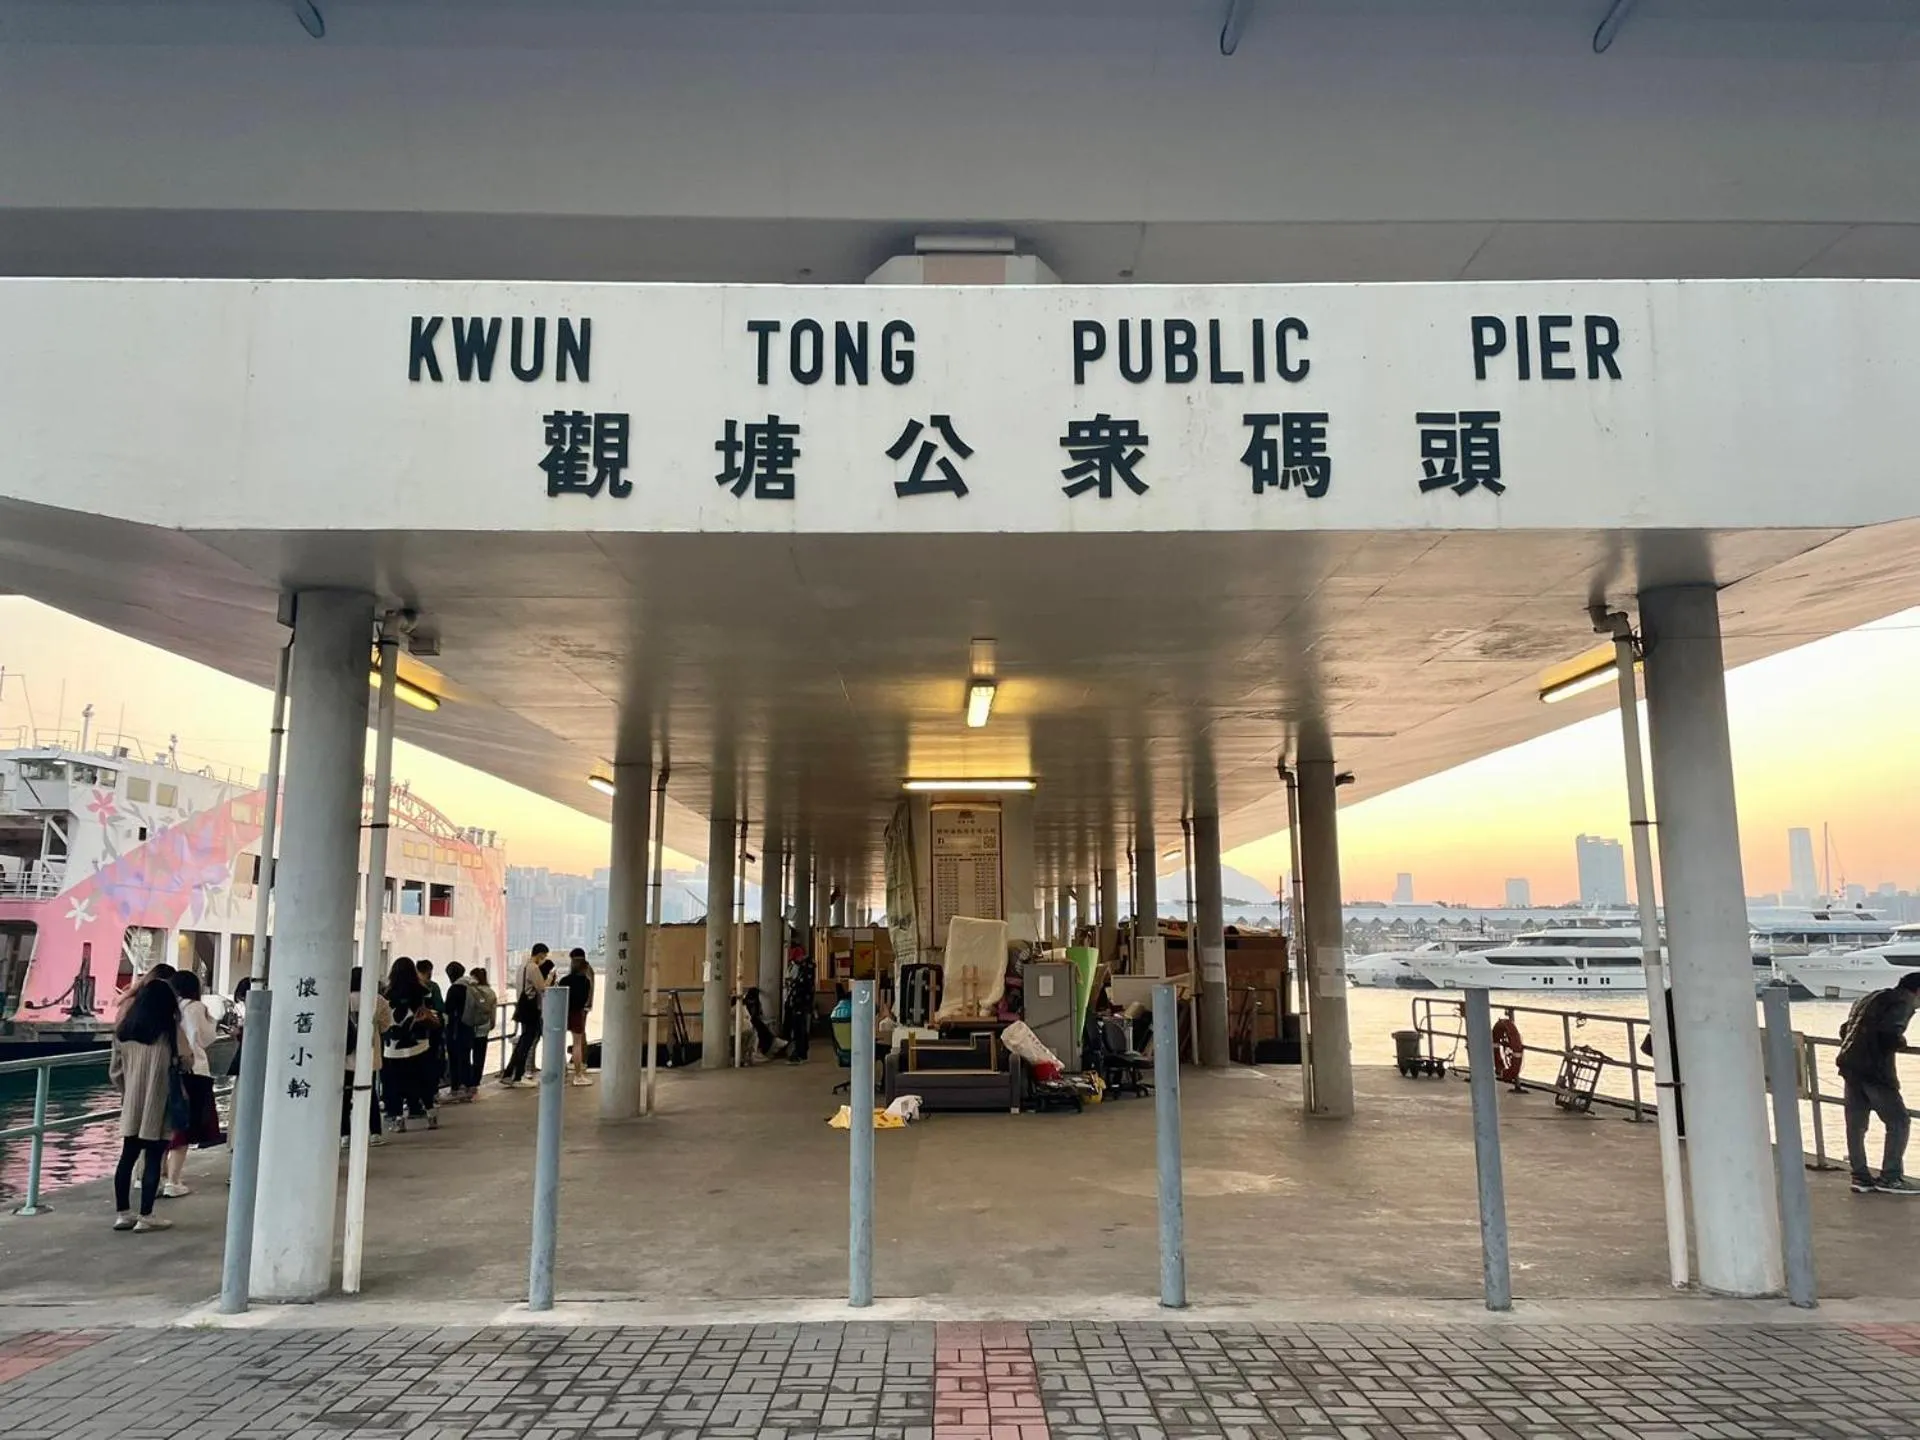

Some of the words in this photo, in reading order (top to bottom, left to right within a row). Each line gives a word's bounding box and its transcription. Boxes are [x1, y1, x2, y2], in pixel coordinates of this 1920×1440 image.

[408, 316, 592, 382] KWUN
[746, 318, 916, 386] TONG
[1072, 316, 1311, 385] PUBLIC
[1470, 314, 1622, 380] PIER
[287, 976, 319, 1099] 懷舊小輪
